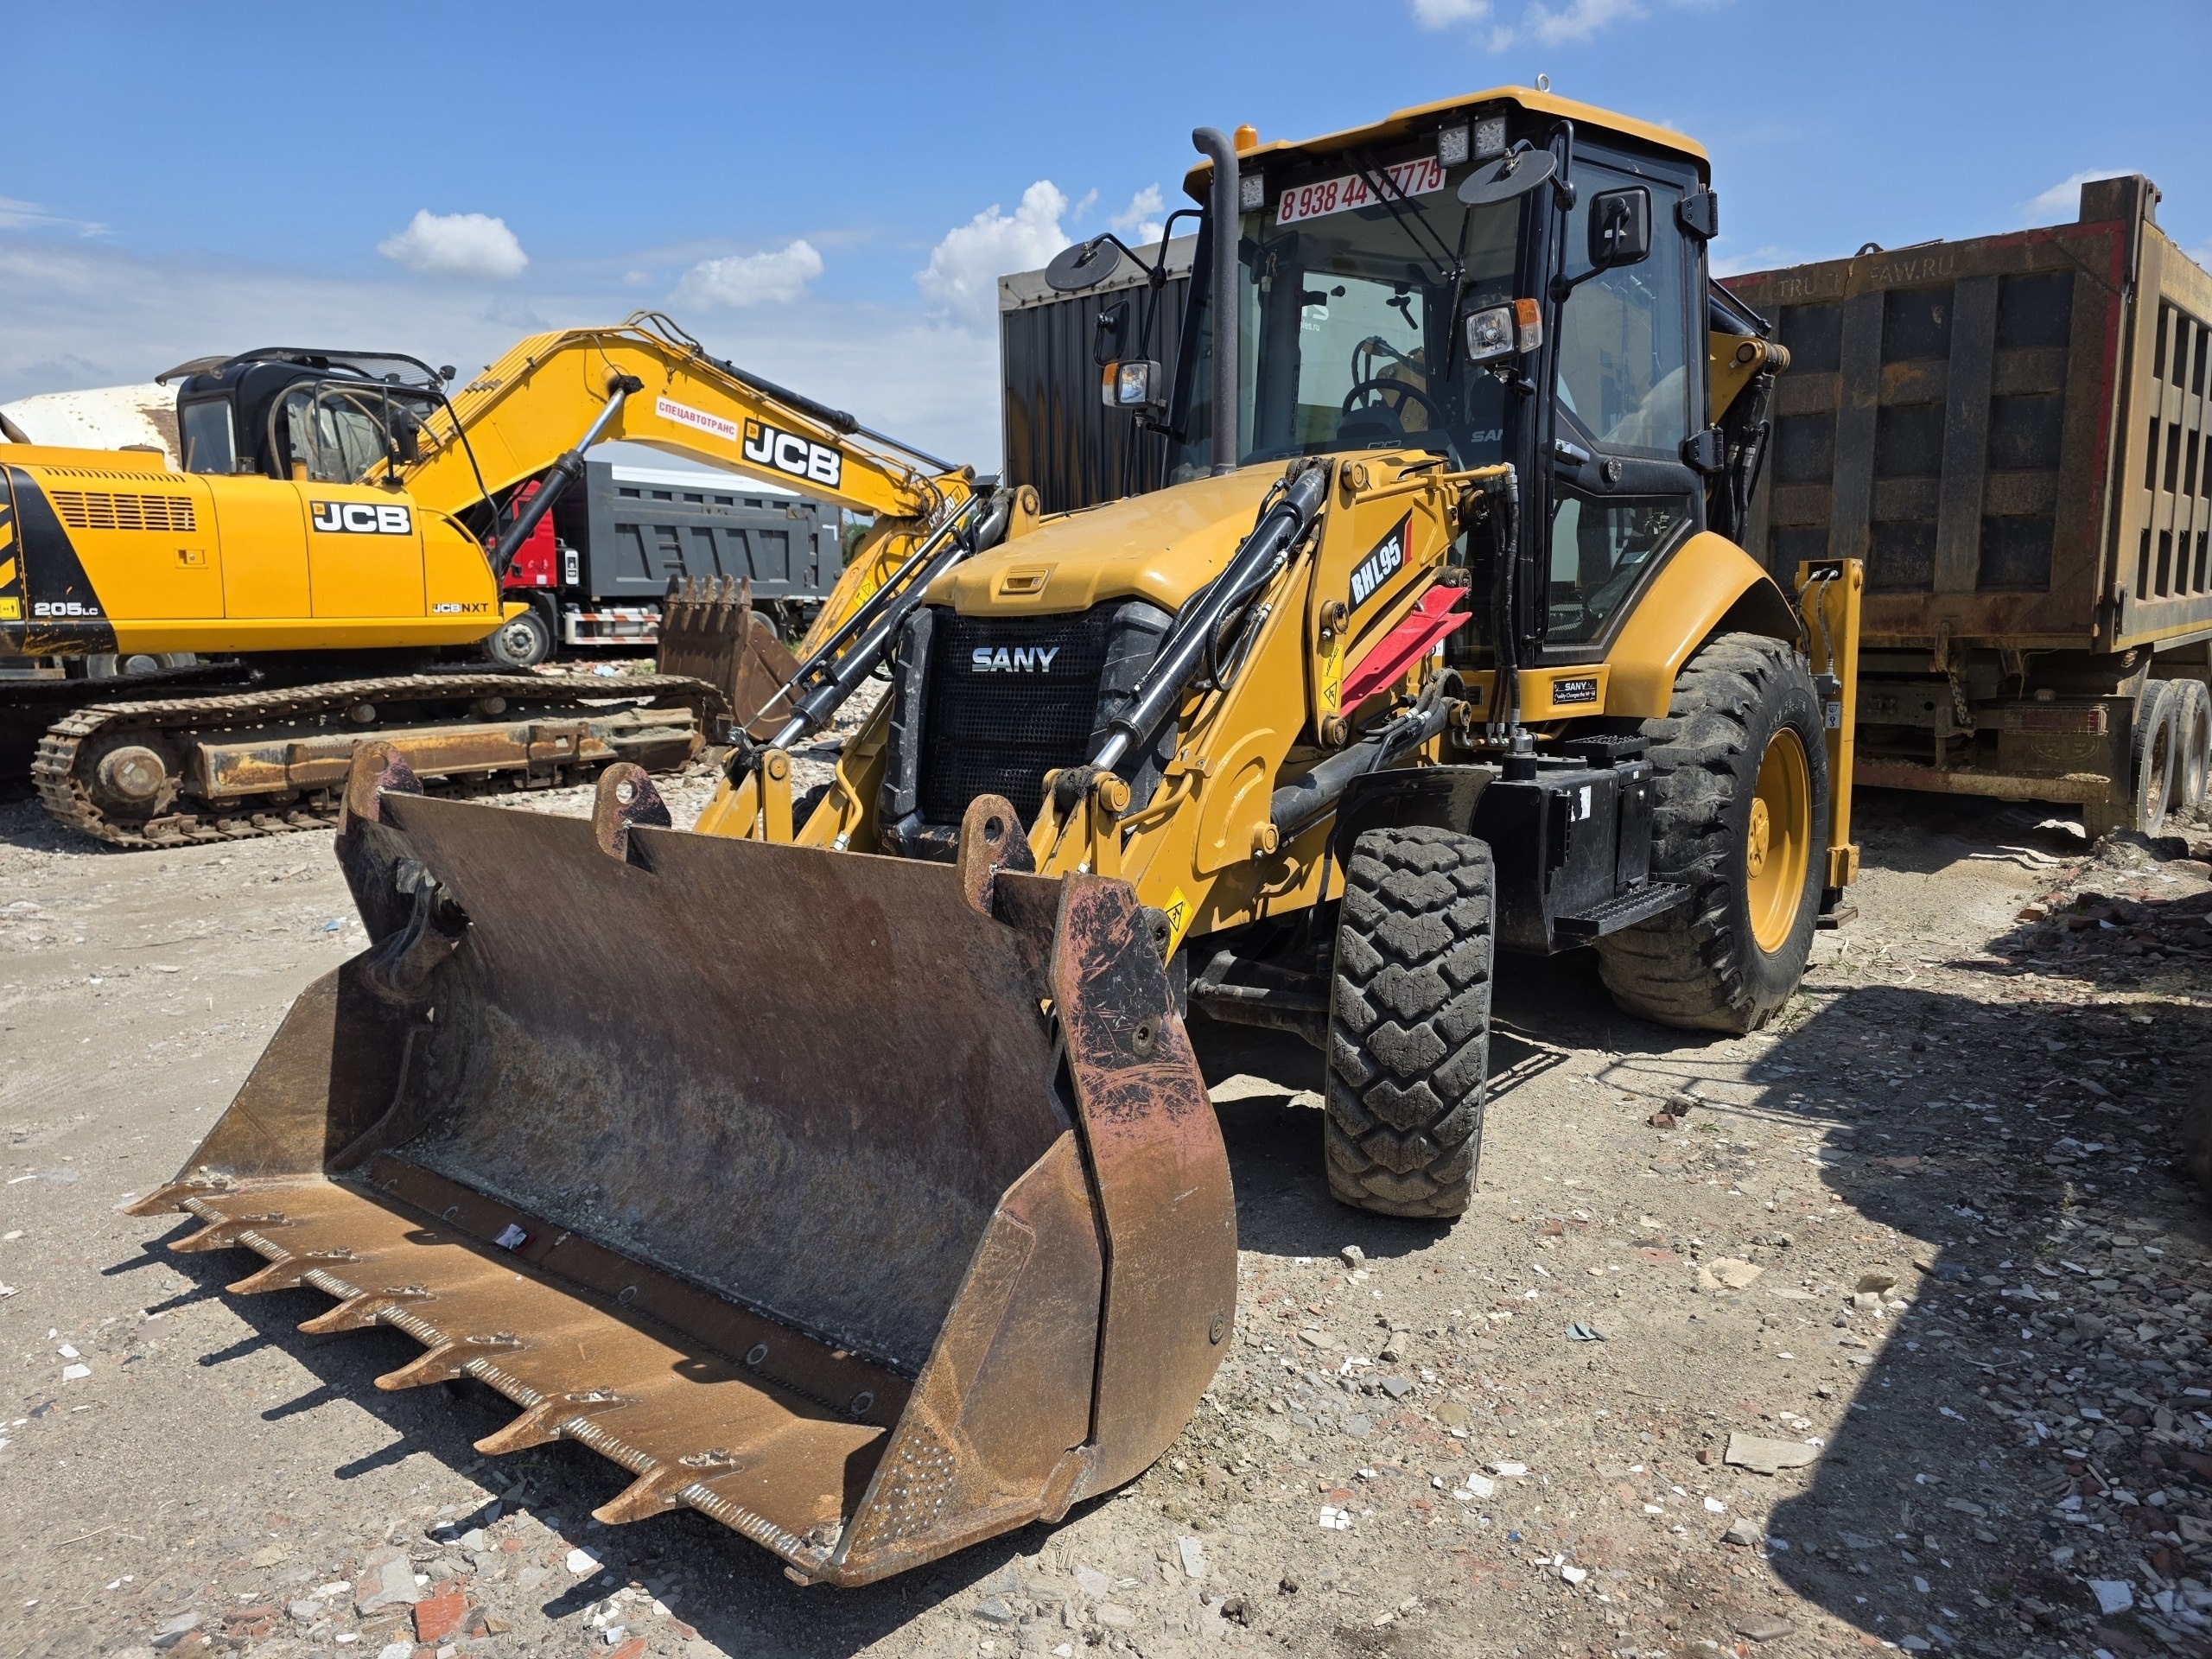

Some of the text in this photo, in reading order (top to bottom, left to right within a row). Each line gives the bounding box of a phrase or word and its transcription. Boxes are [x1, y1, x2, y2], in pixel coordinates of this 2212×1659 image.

[1281, 191, 1296, 221] 8
[1299, 182, 1338, 217] 938
[1341, 177, 1368, 207] 44
[658, 401, 735, 435] СПЕЦАВТОТРАНС
[745, 427, 840, 486] JCB
[314, 504, 410, 533] JCB
[1351, 536, 1401, 604] BHL95
[971, 646, 1060, 672] SANY
[1565, 682, 1587, 691] SANY
